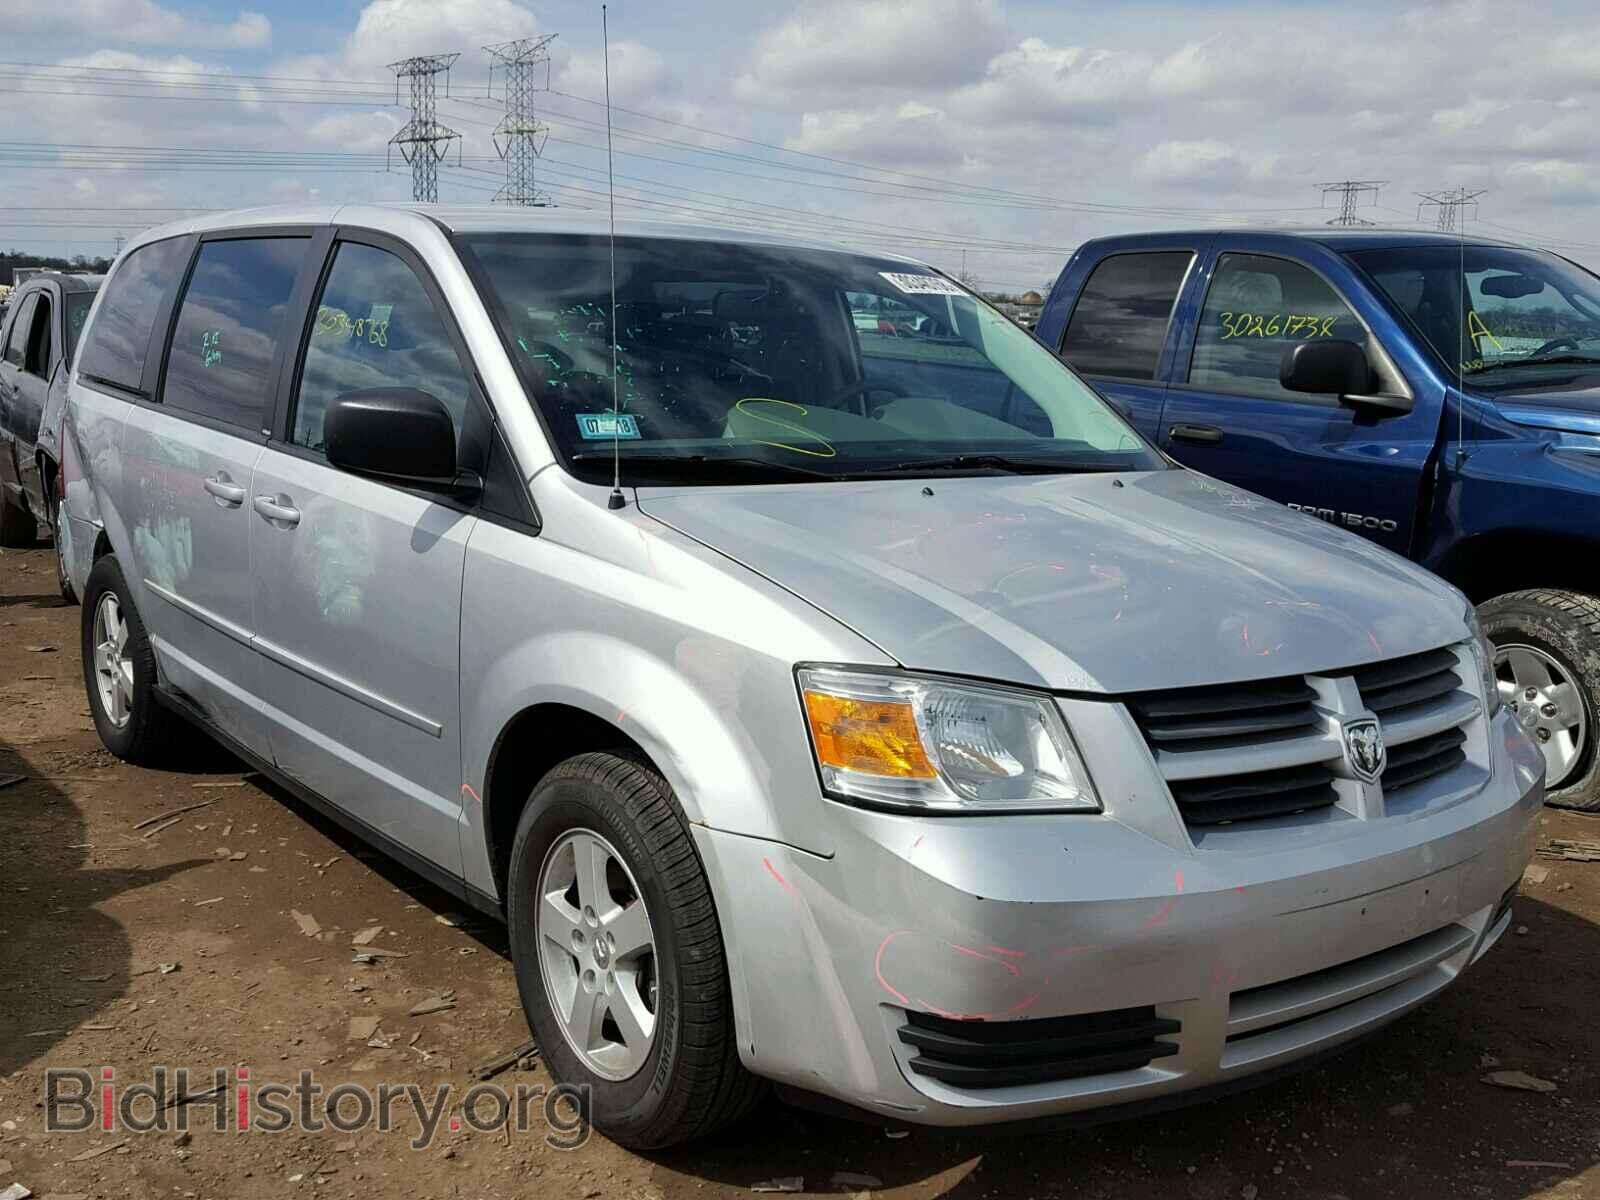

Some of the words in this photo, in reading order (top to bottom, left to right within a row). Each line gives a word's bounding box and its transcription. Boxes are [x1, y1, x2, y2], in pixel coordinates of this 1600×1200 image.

[1220, 312, 1338, 340] 30261738
[1468, 311, 1504, 353] A
[585, 418, 600, 433] 07
[1341, 512, 1398, 532] 1500
